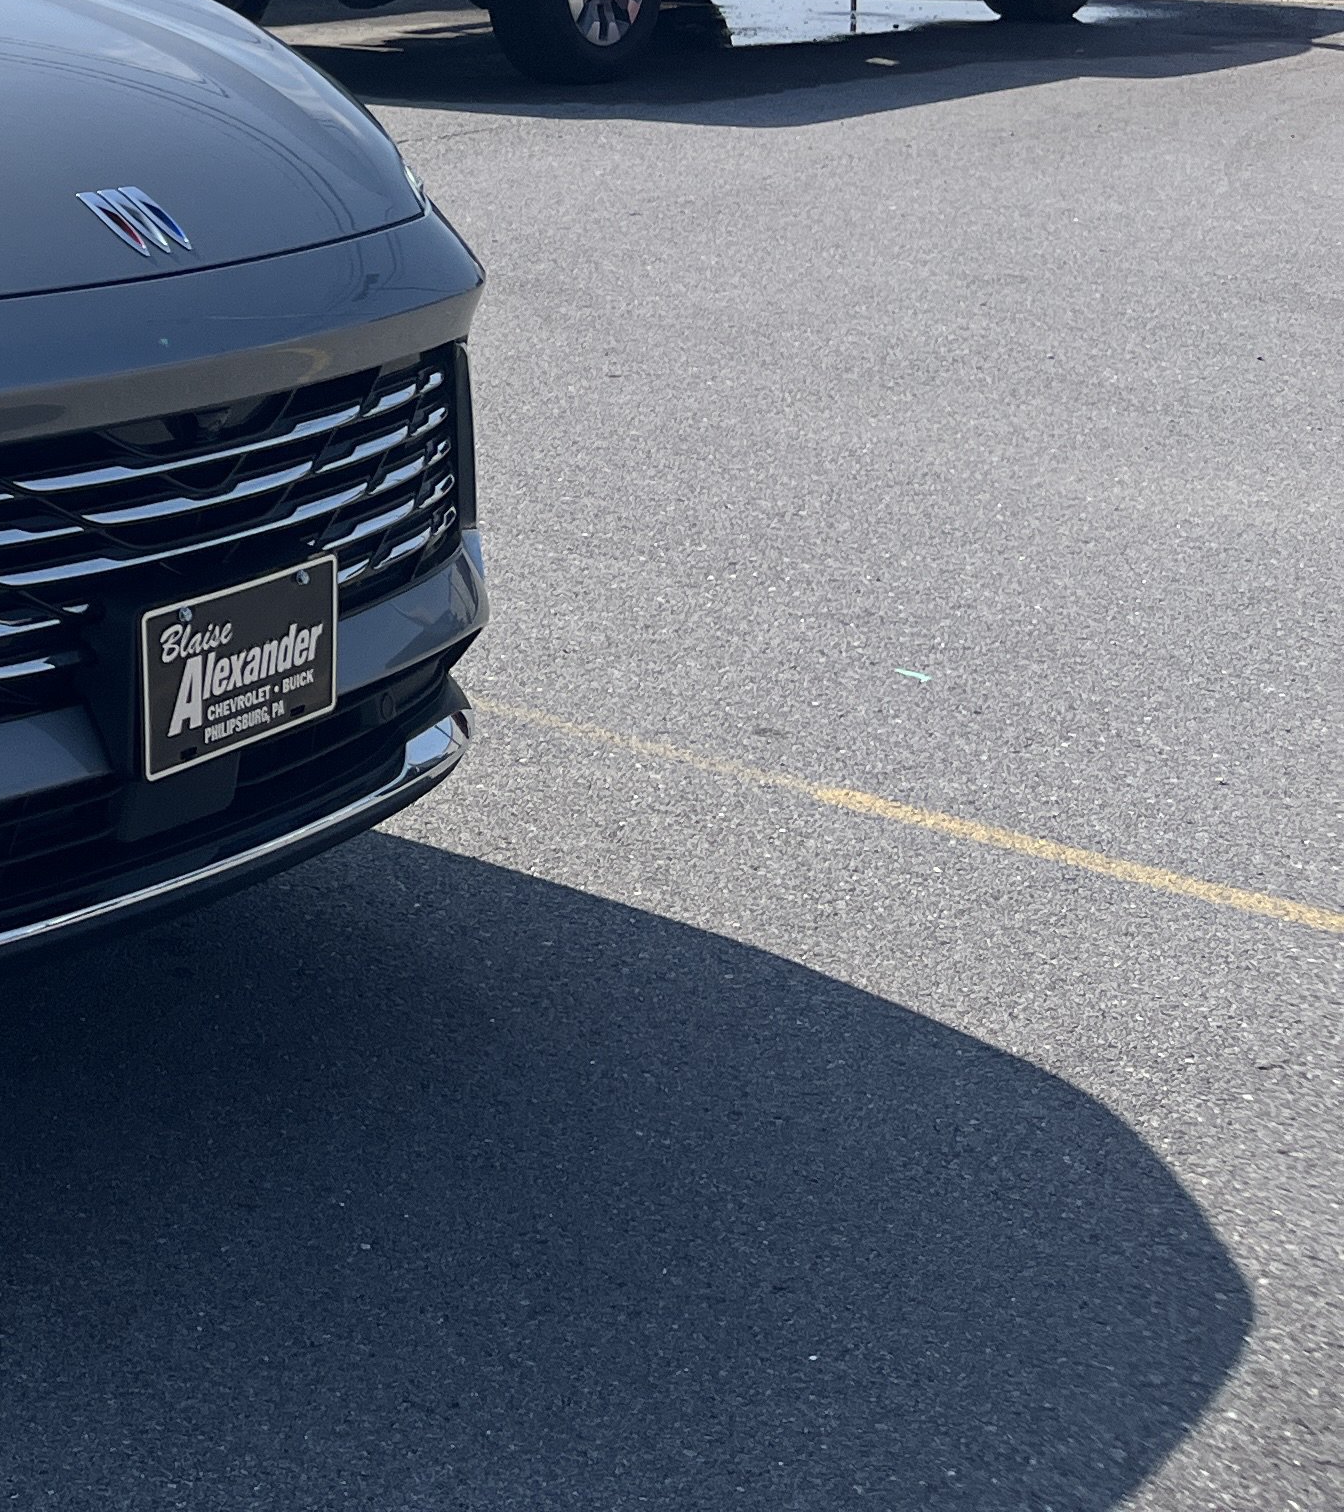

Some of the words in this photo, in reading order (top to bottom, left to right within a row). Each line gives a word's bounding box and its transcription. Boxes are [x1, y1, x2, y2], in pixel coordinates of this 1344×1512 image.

[160, 622, 233, 664] Blaise
[167, 622, 324, 738] Alexander
[207, 685, 271, 721] CHEVROLET
[282, 669, 314, 694] BUICK
[204, 707, 270, 744] PHILIPSBURG,
[272, 699, 285, 719] PA
